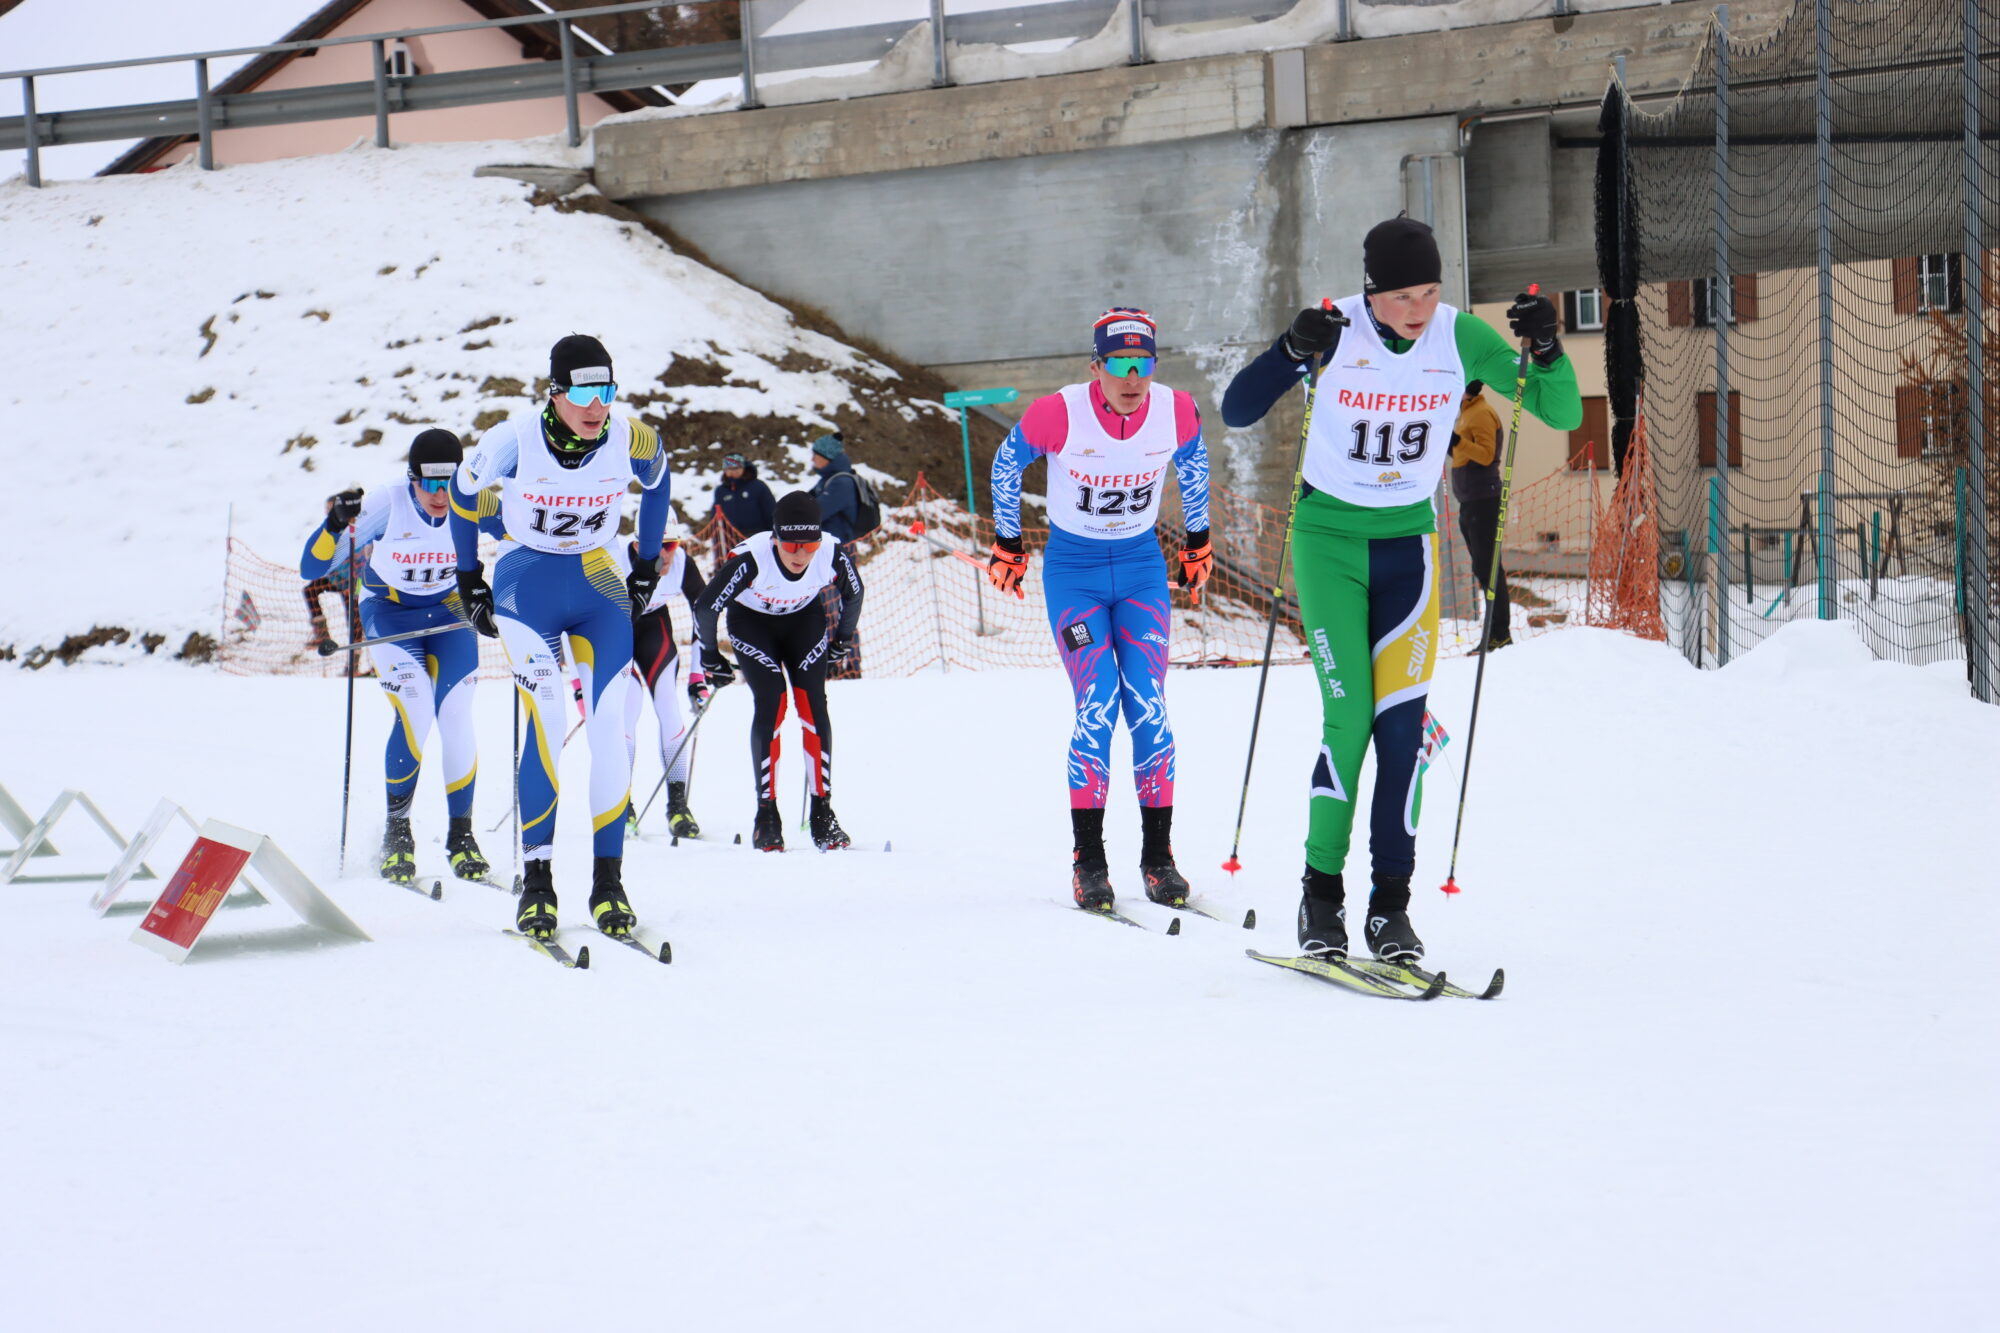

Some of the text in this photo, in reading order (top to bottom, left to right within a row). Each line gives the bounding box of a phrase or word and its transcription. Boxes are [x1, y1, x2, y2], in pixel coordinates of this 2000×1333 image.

[1338, 388, 1452, 413] RAIFFEISEN
[1347, 419, 1432, 466] 119
[1076, 481, 1157, 517] 125
[530, 507, 610, 538] 124
[391, 552, 457, 564] RAIFFEIS
[711, 562, 748, 612] PELTONEN
[1070, 623, 1087, 636] NO
[728, 633, 782, 673] PELTONEN
[512, 670, 538, 693] rtful
[1328, 678, 1346, 699] AG
